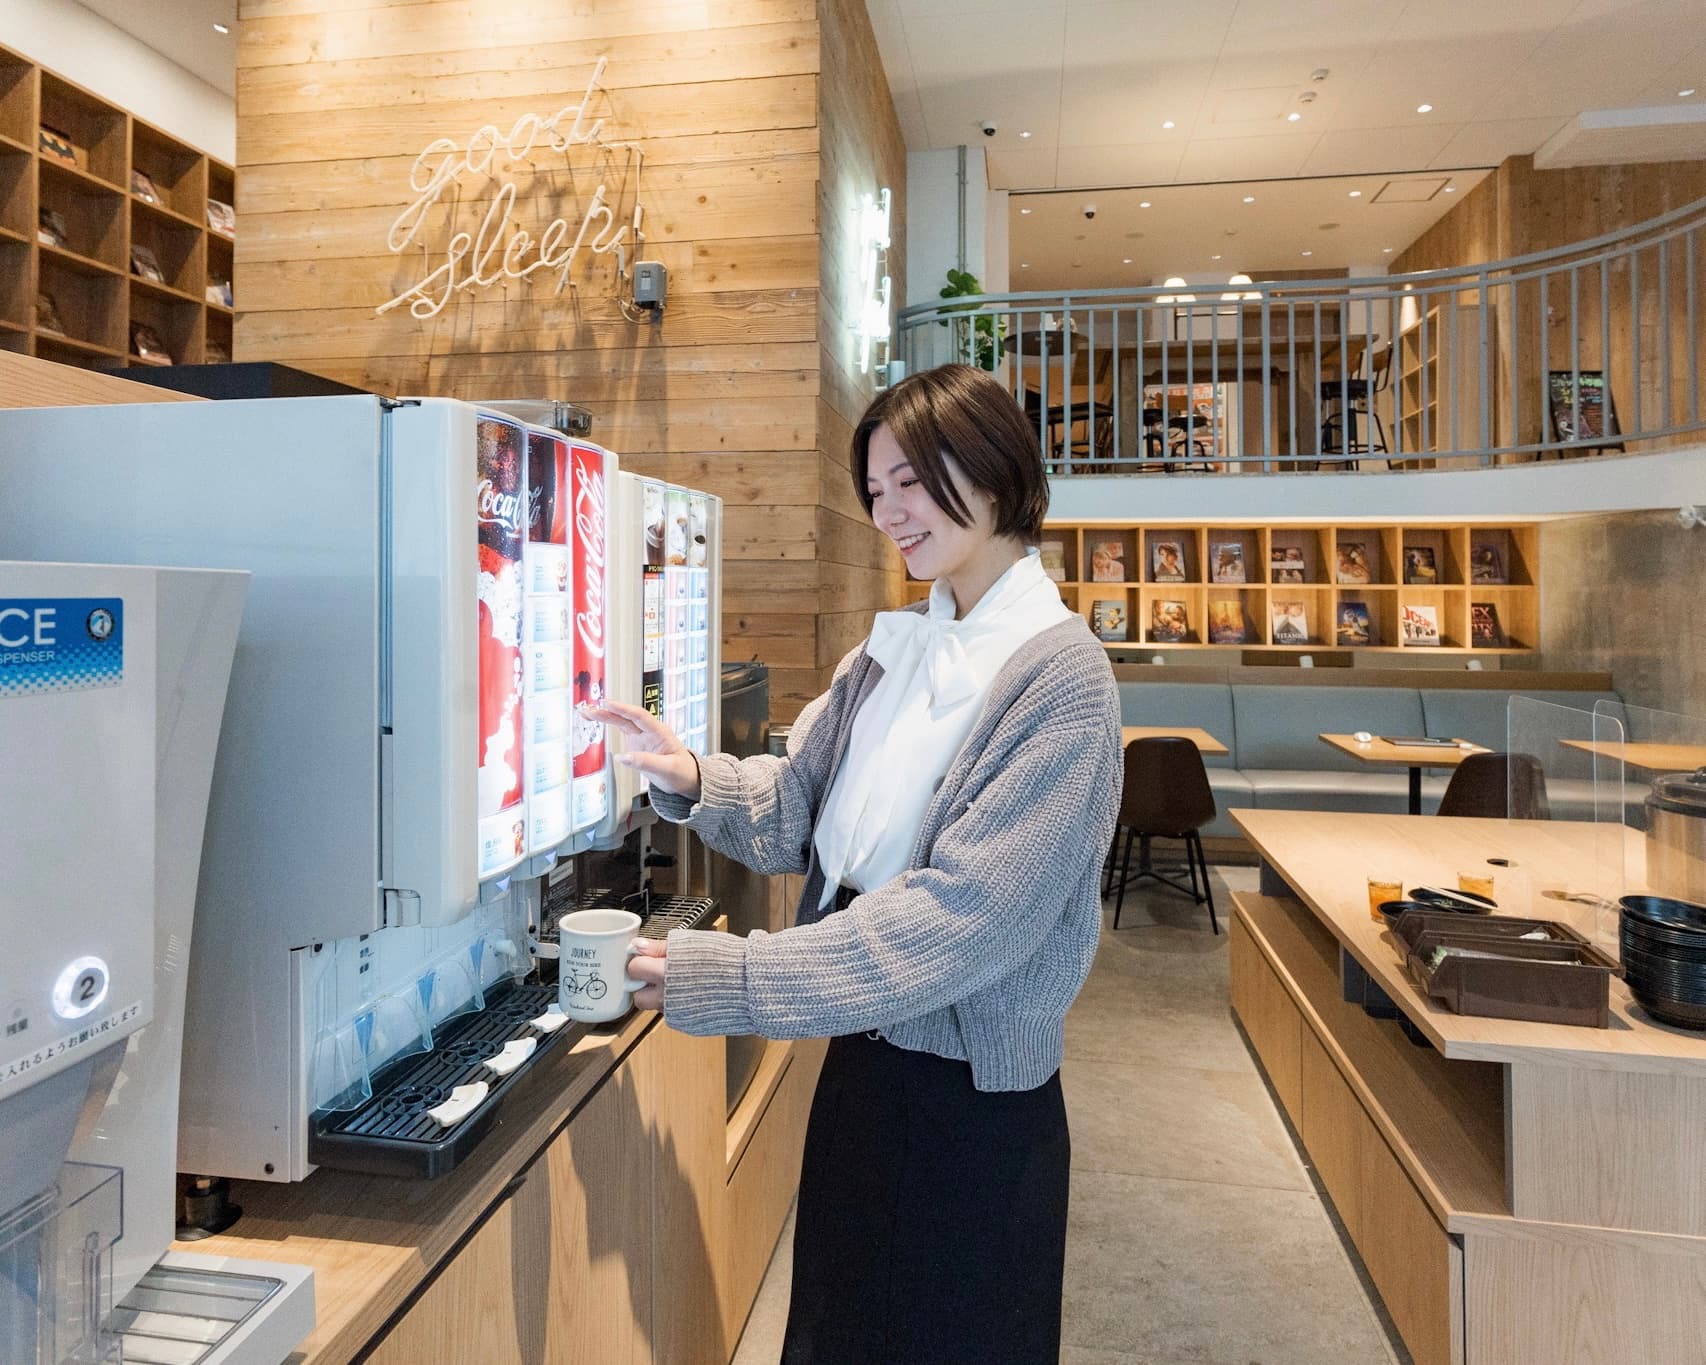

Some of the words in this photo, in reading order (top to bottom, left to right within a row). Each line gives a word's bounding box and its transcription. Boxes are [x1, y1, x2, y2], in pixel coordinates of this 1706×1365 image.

[388, 56, 607, 252] good
[375, 183, 629, 319] sleep
[80, 976, 95, 1001] 2
[571, 947, 597, 959] JOURNEY
